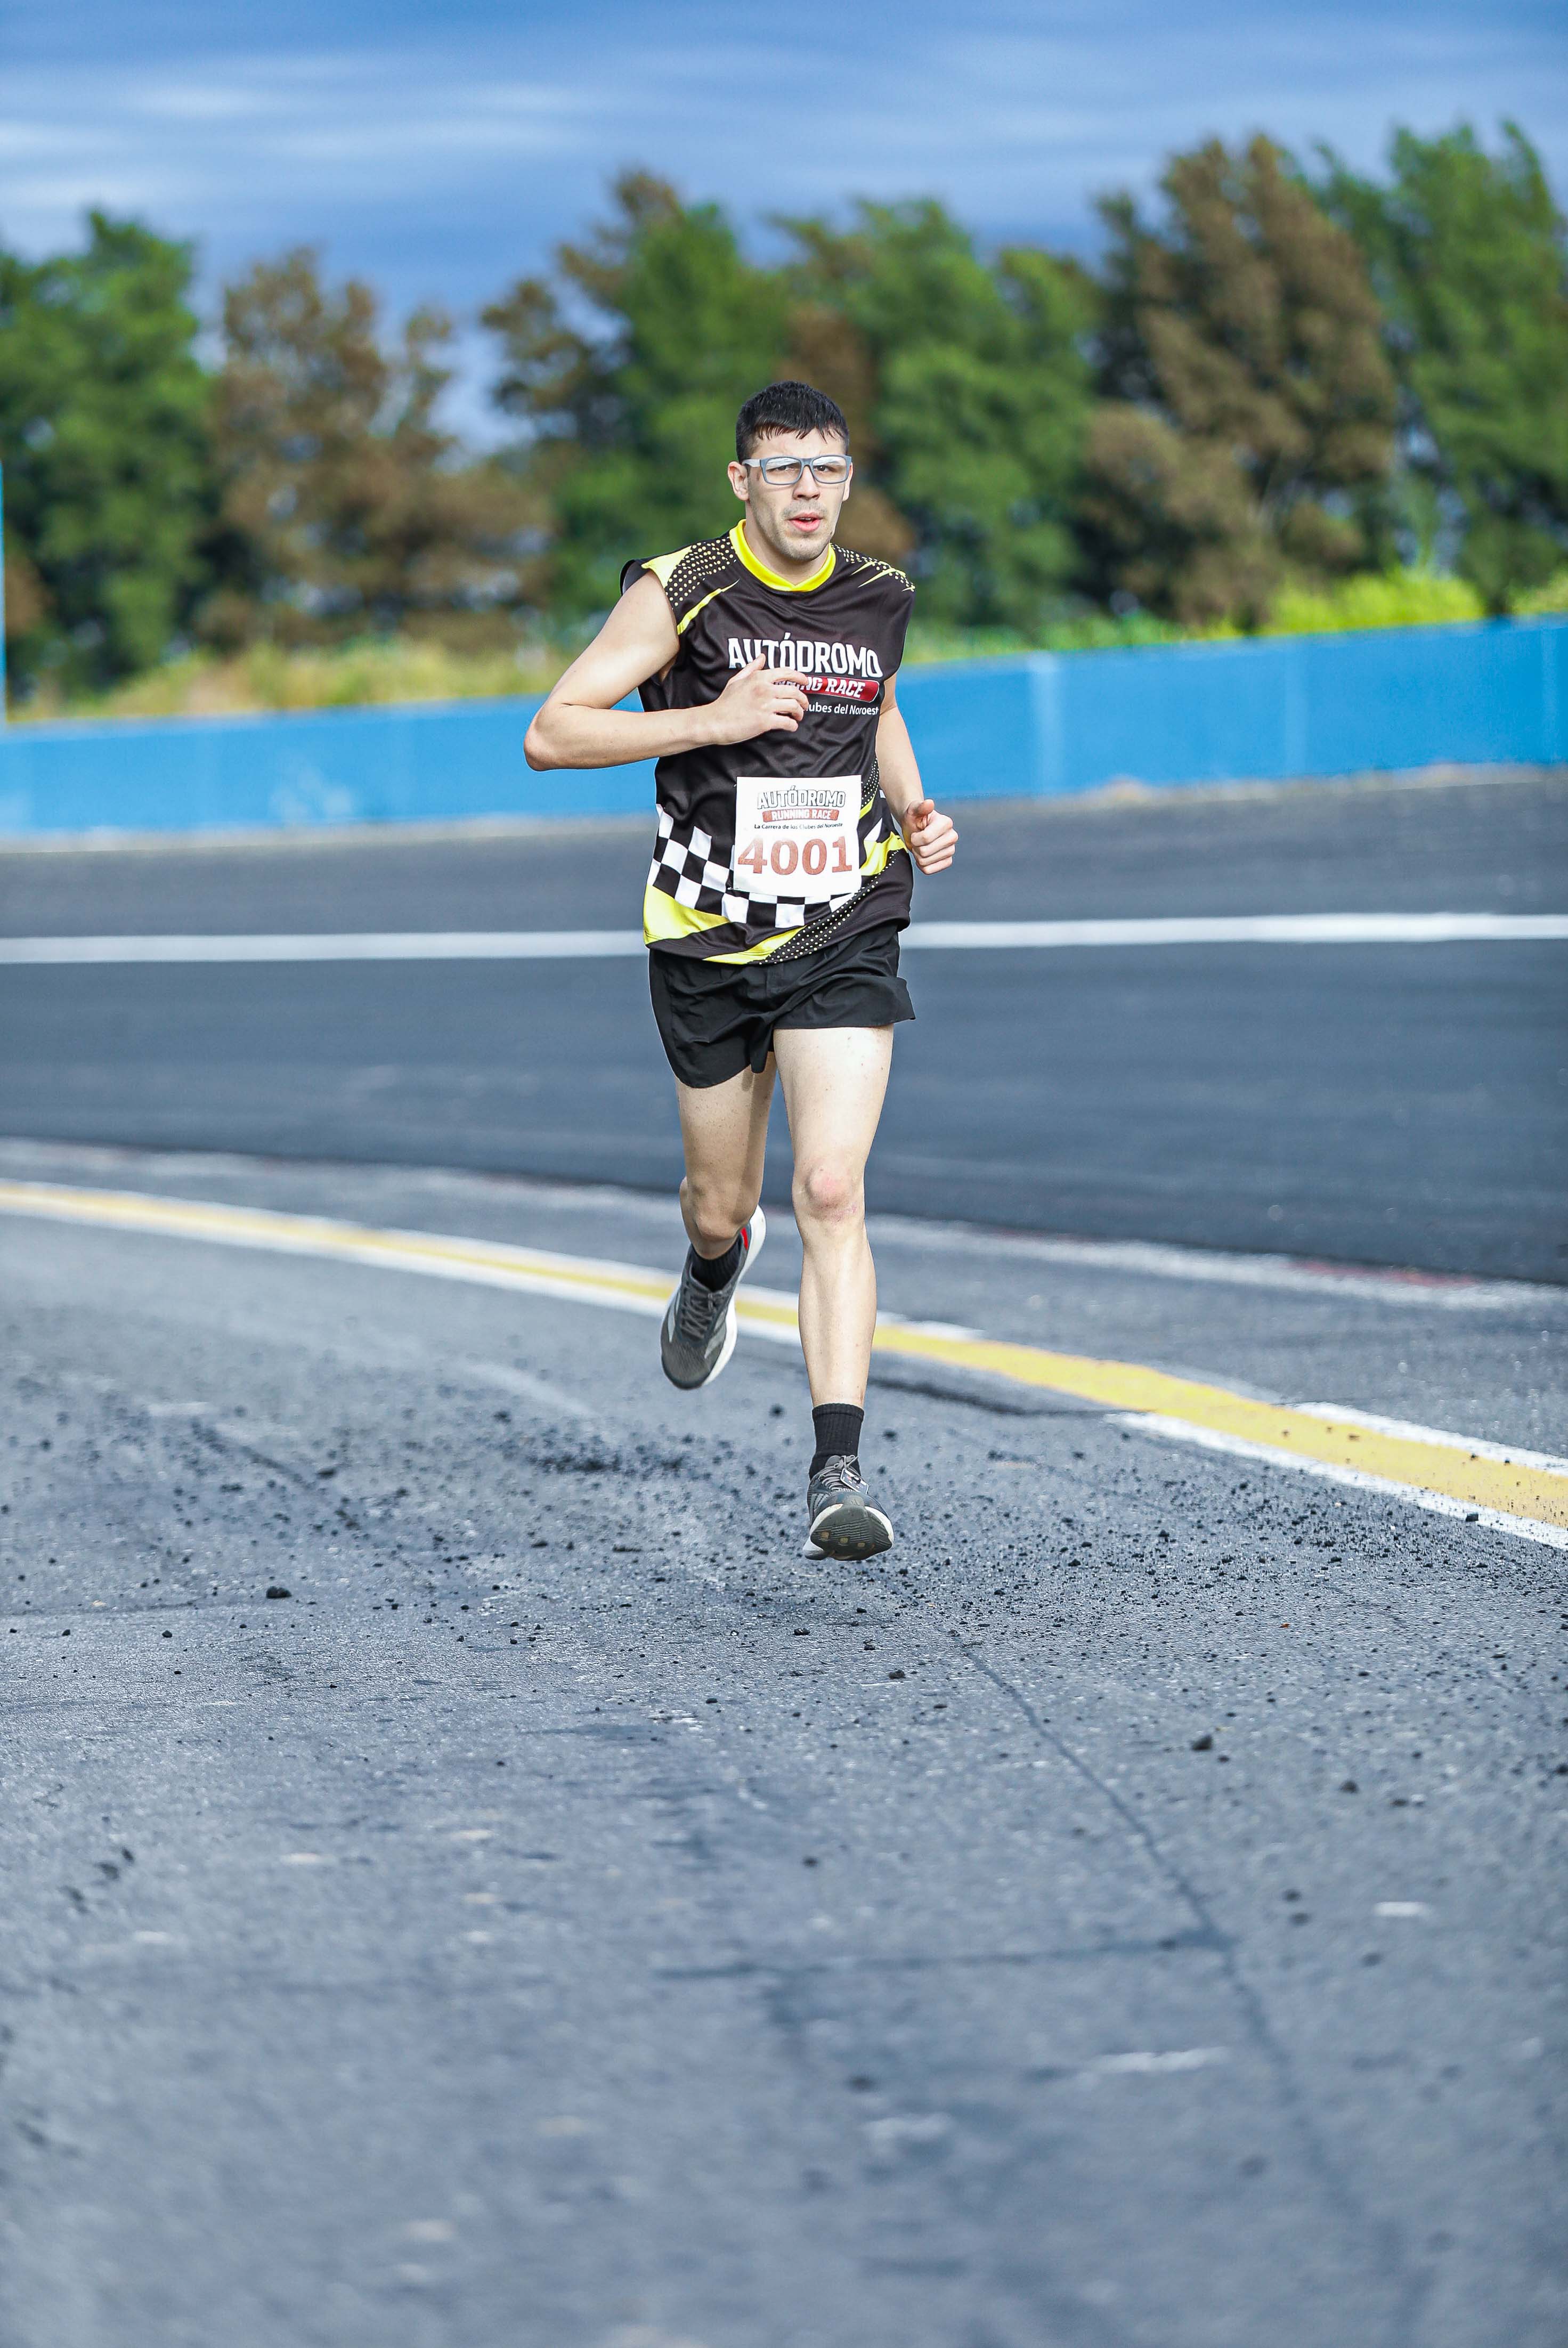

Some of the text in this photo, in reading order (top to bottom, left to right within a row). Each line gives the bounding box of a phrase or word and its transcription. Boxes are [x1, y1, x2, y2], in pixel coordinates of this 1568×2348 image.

[728, 632, 883, 678] AUTÓDROMO
[825, 678, 865, 698] RACE
[806, 702, 879, 715] ubes del Noroest
[757, 785, 846, 809] AUTÓDROMO
[771, 809, 831, 820] RUNNING RACE
[738, 835, 852, 875] 4001
